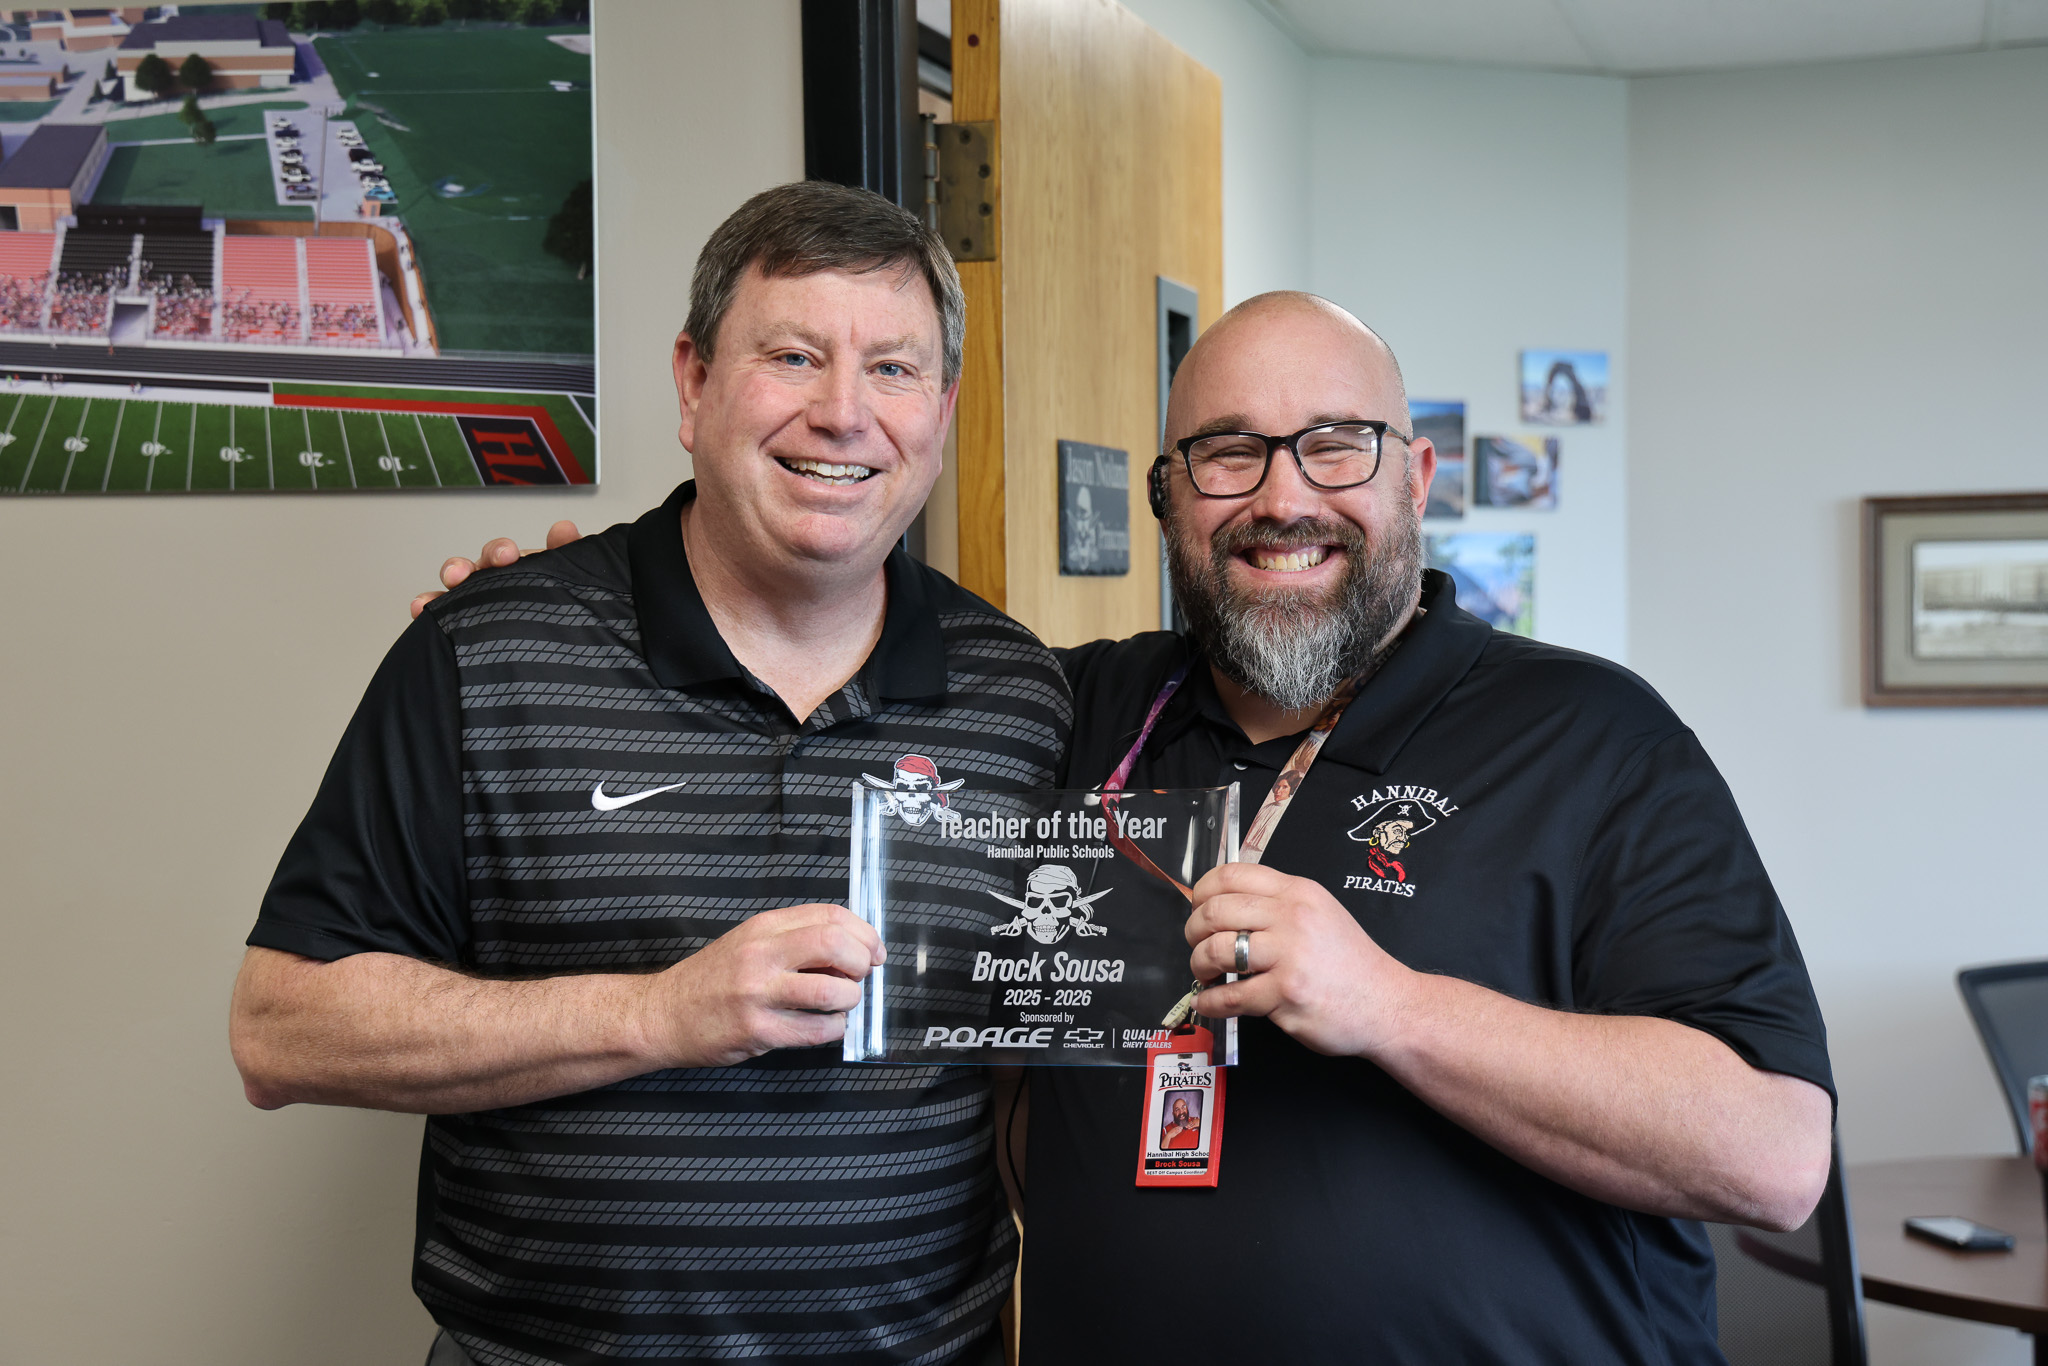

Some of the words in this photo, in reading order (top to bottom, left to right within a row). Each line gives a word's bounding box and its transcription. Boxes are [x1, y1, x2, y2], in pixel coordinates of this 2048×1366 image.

[299, 451, 324, 468] 20
[378, 455, 404, 472] 10
[1350, 785, 1459, 817] HANNIBAL
[937, 811, 1030, 839] Teacher
[1037, 811, 1062, 839] of
[1068, 811, 1107, 839] the
[1114, 811, 1167, 839] Year
[987, 845, 1034, 858] Hannibal
[1037, 845, 1070, 858] Public
[1072, 845, 1115, 859] Schools
[1343, 875, 1416, 897] PIRATES
[972, 951, 1046, 982] Brock
[1050, 951, 1125, 983] Sousa
[1003, 989, 1042, 1006] 2025
[1053, 989, 1092, 1006] 2026
[1020, 1012, 1062, 1024] Sponsored
[1065, 1012, 1074, 1024] by
[923, 1027, 1054, 1048] POAGE
[1122, 1029, 1172, 1041] QUALITY
[1159, 1073, 1212, 1088] PIRATES
[1175, 1151, 1189, 1159] High
